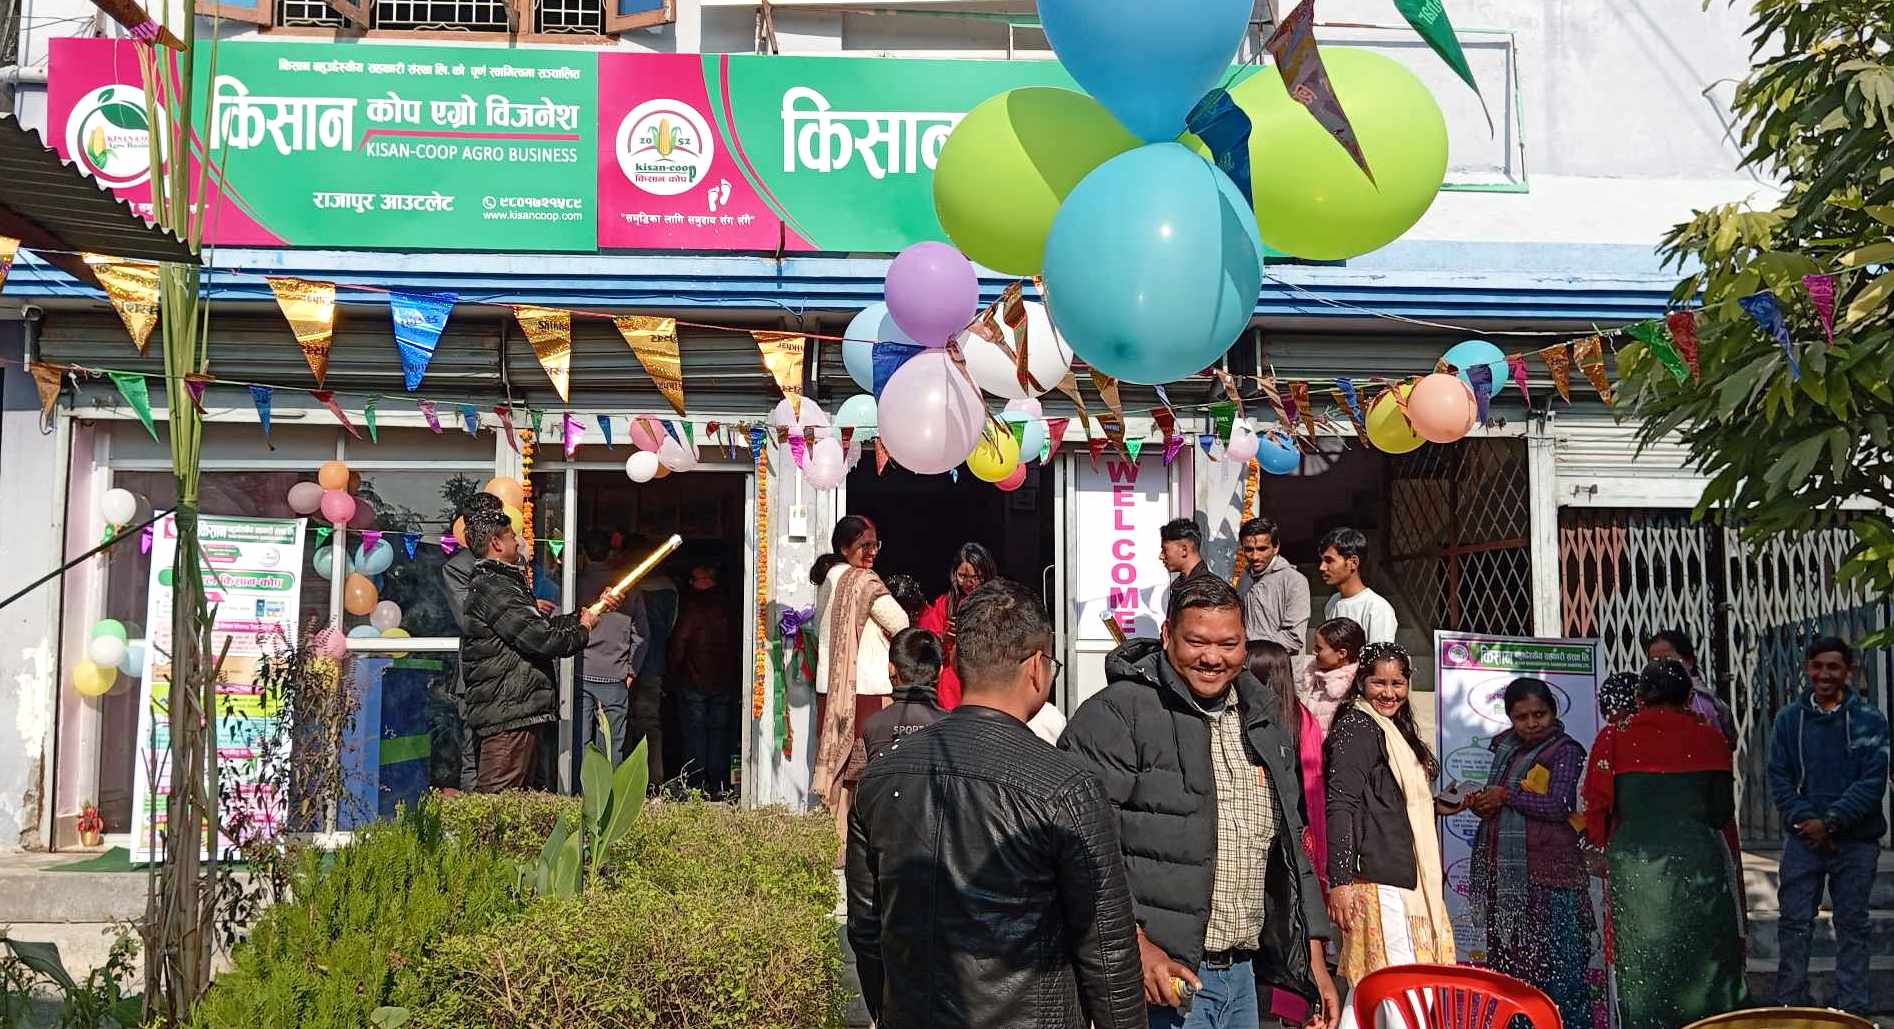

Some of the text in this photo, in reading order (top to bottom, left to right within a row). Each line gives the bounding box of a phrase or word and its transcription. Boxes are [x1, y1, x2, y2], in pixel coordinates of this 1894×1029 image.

[210, 75, 357, 155] किसान
[366, 91, 422, 124] कोप
[430, 94, 478, 129] एग्रो
[366, 142, 578, 162] KISAN-COOP AGRO BUSINESS
[313, 190, 454, 214] राजापुर आउटलेट
[483, 210, 582, 223] www.kisancoop.com
[1106, 460, 1140, 634] WELCOME
